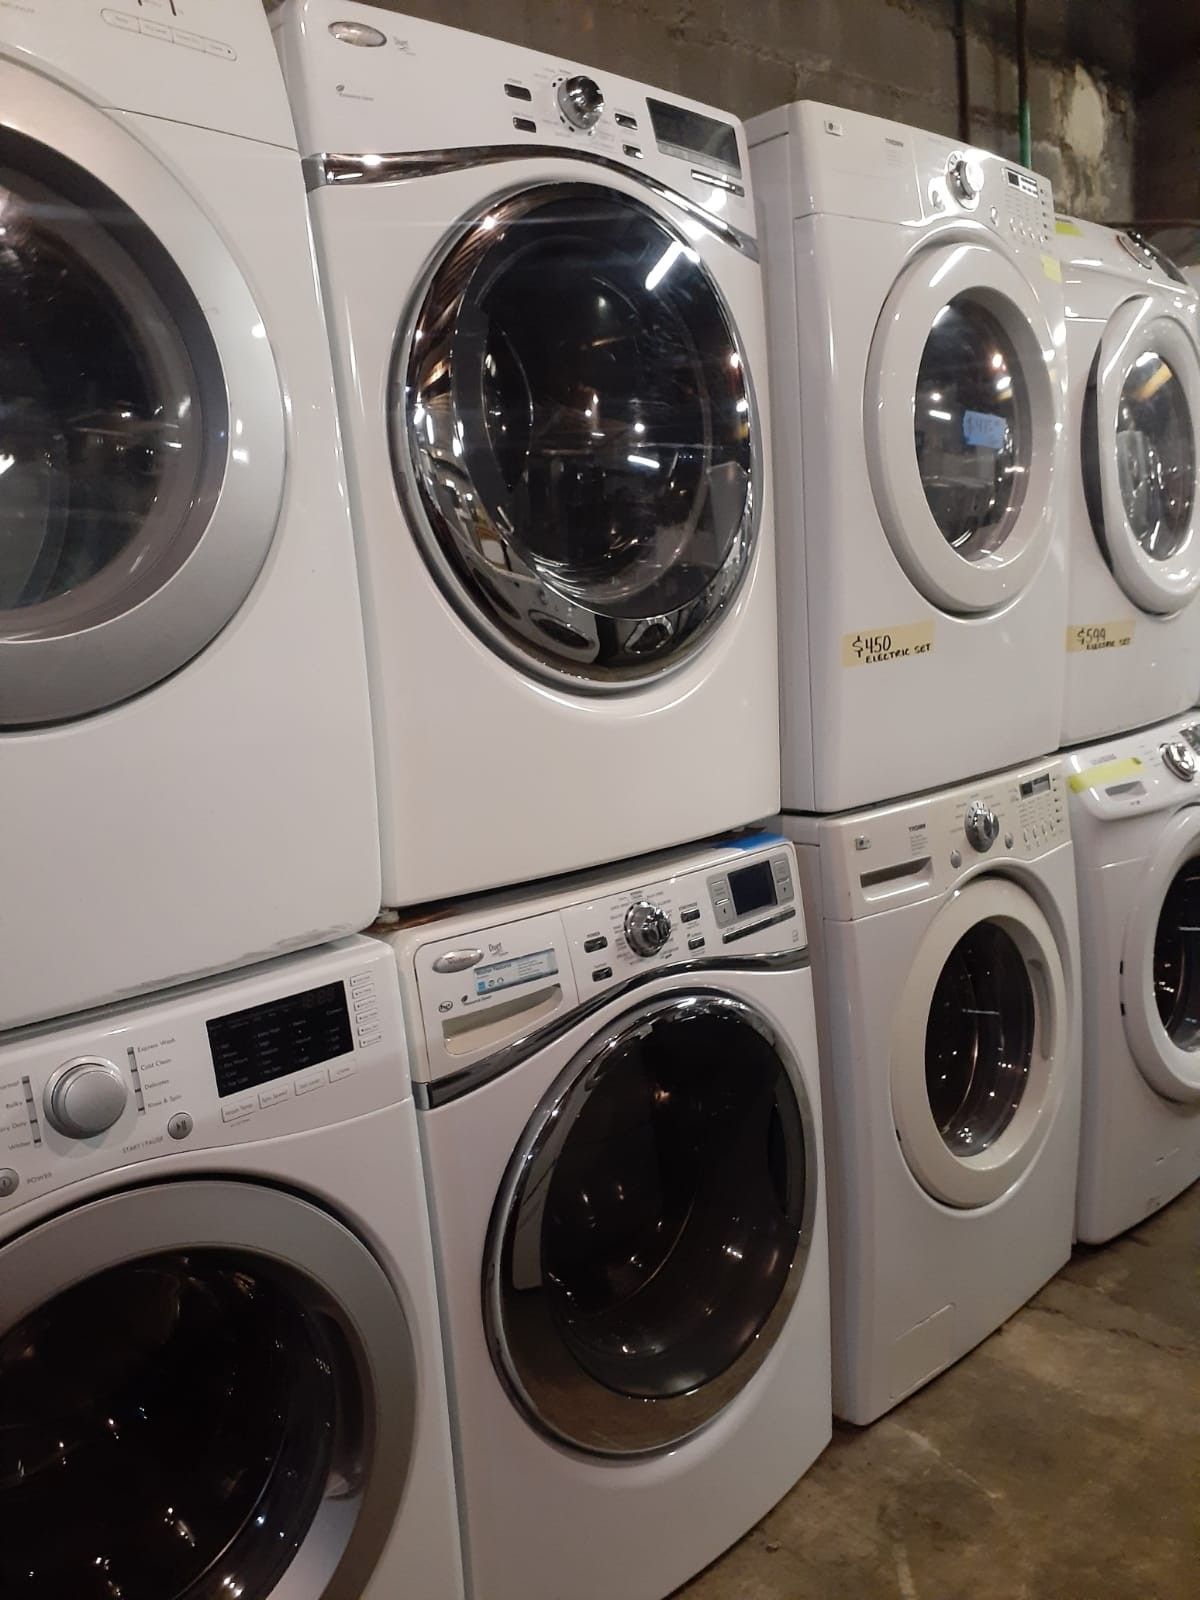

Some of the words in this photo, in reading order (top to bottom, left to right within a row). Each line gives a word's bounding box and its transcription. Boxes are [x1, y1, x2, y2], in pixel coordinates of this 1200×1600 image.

[852, 635, 892, 658] $450
[1076, 627, 1107, 646] $599
[866, 647, 911, 664] ELECTRIC
[914, 643, 932, 655] SET
